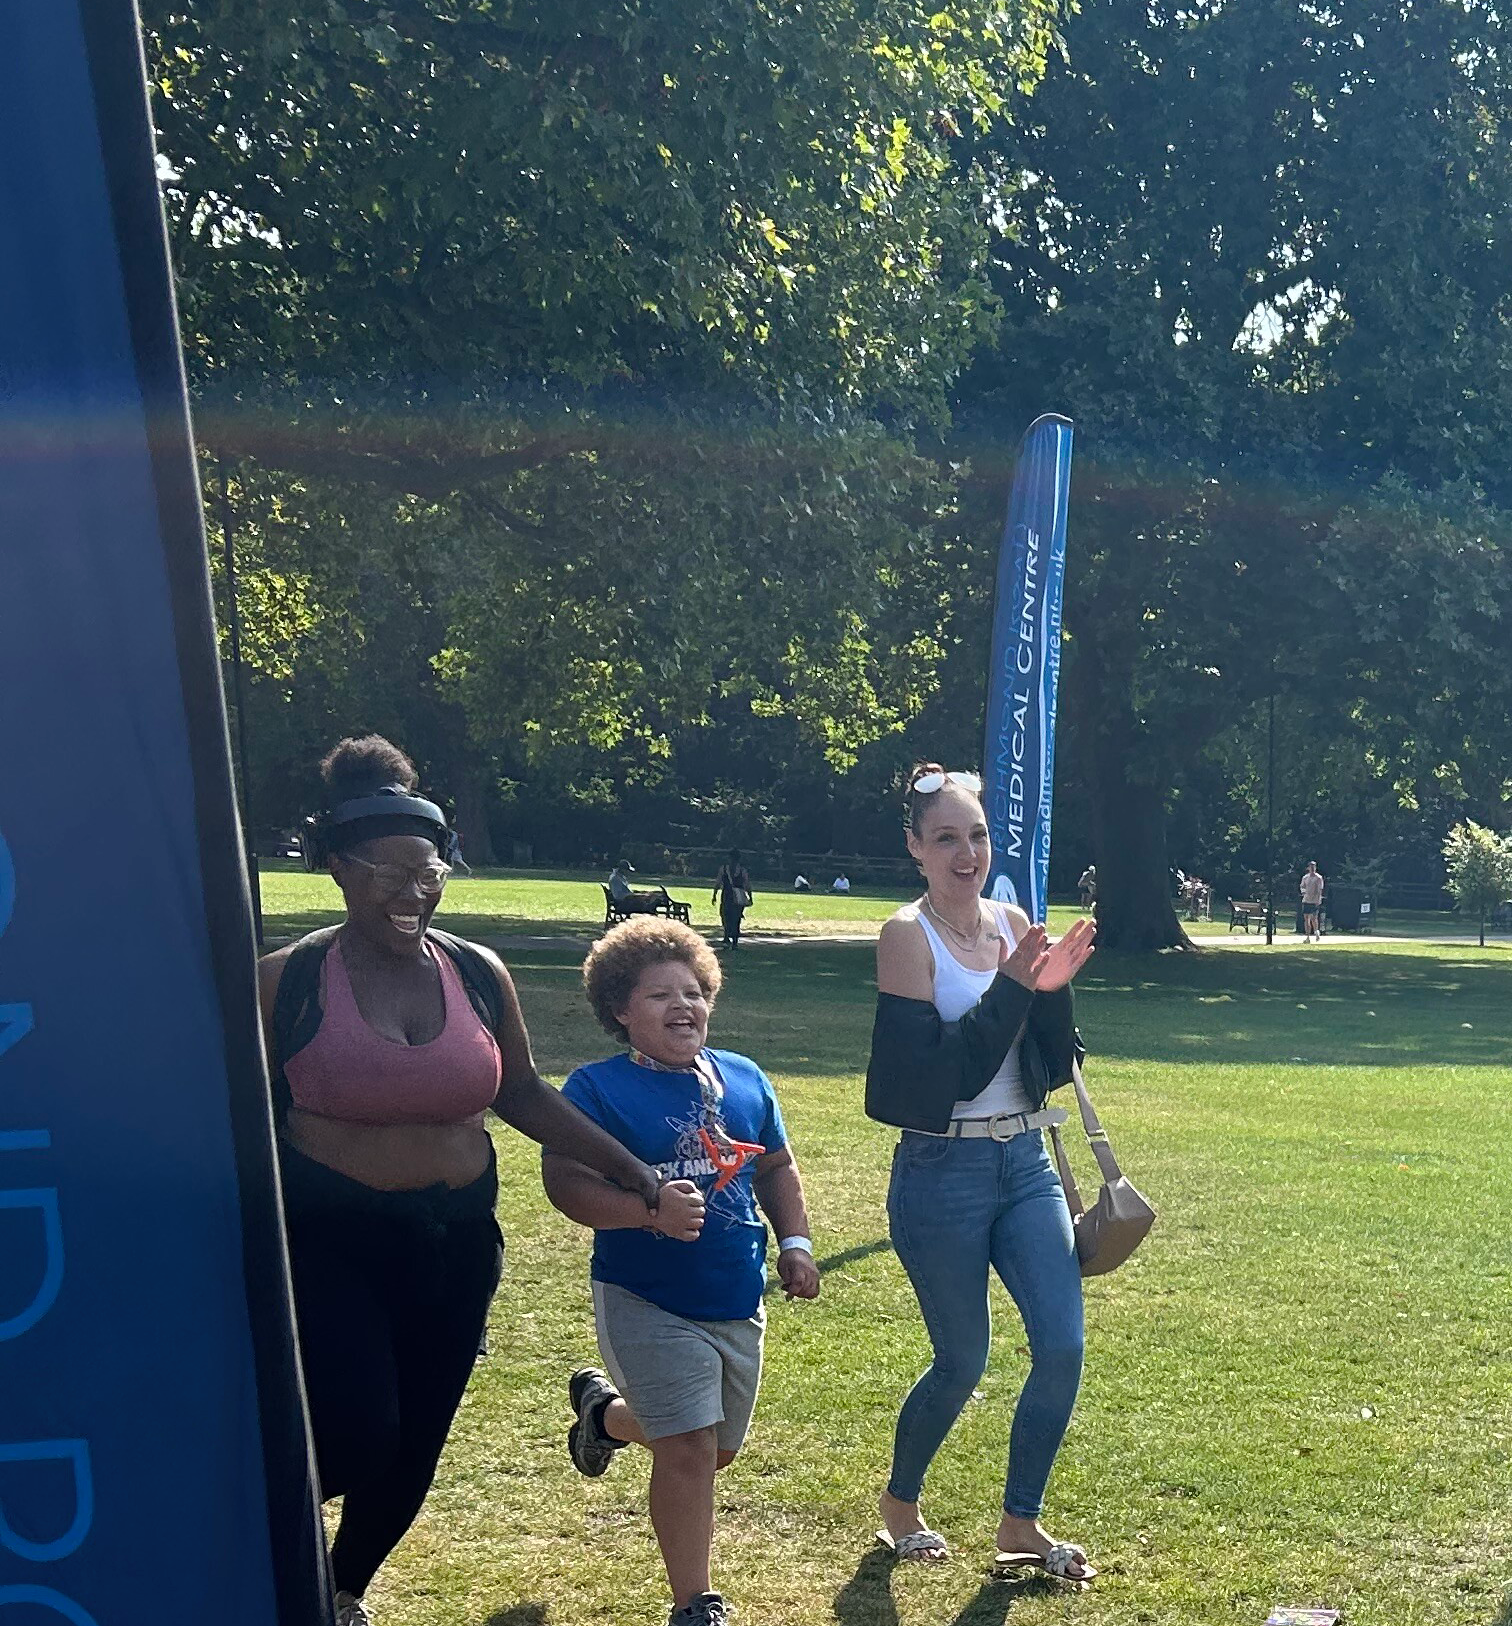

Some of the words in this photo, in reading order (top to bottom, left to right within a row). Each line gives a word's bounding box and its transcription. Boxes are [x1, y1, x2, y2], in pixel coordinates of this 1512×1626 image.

[1017, 527, 1041, 674] CENTRE
[1007, 687, 1031, 859] MEDICAL
[683, 1158, 719, 1177] AND
